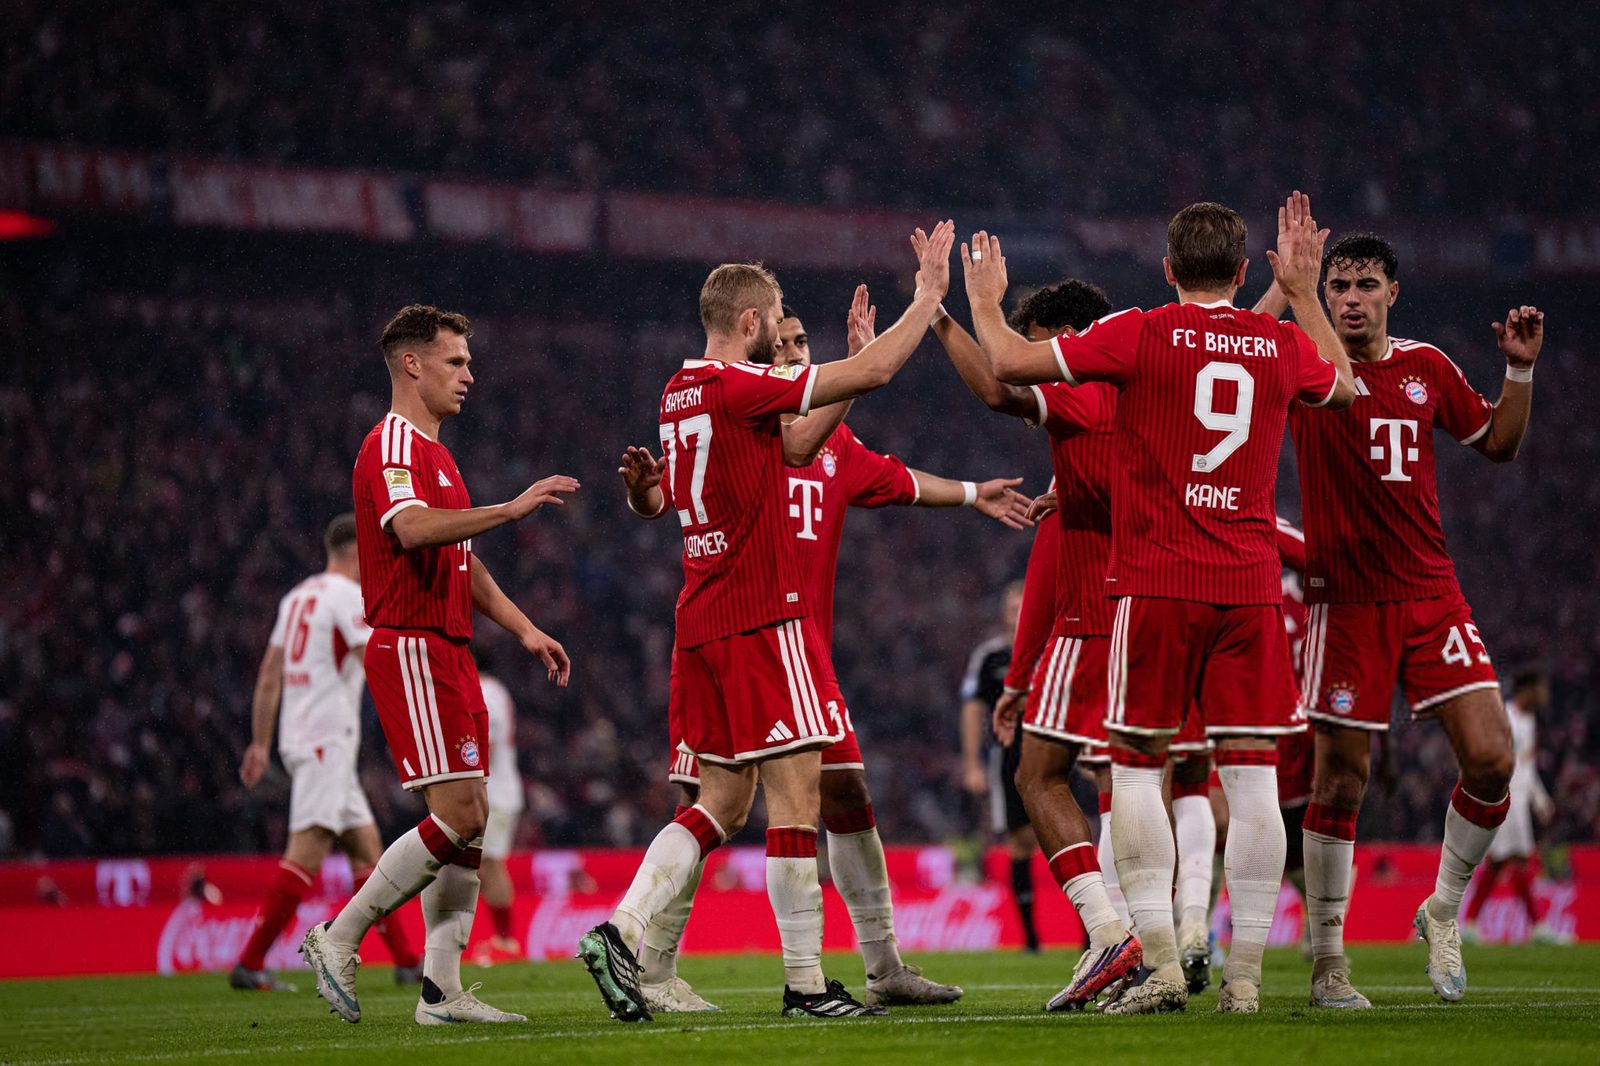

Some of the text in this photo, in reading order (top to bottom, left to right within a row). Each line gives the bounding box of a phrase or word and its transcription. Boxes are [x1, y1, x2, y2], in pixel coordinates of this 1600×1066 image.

[1172, 328, 1278, 358] FC BAYERN
[665, 385, 703, 413] BAYERN
[1191, 361, 1255, 473] 9
[1369, 417, 1419, 482] T
[787, 476, 824, 541] T
[1185, 482, 1241, 511] KANE
[283, 596, 317, 664] 16
[1441, 625, 1492, 667] 45
